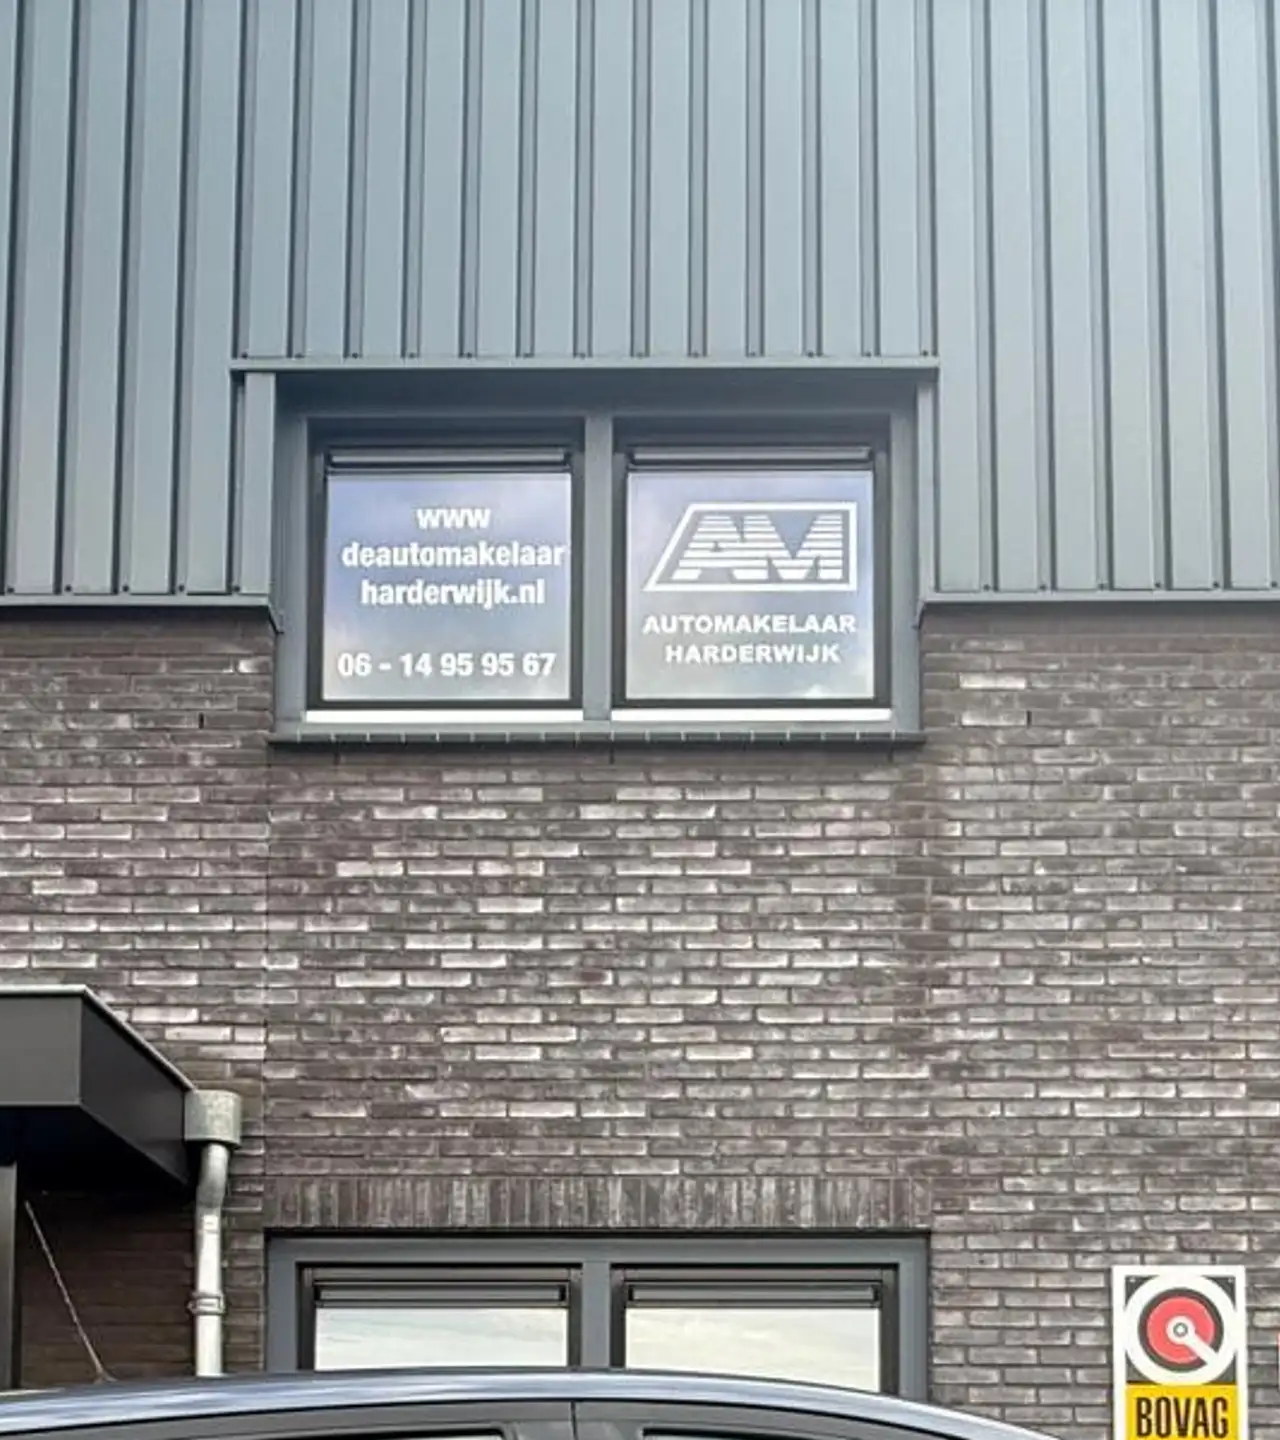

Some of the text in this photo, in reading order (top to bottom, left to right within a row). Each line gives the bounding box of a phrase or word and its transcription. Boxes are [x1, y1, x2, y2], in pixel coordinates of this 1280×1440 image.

[417, 508, 490, 530] www
[341, 540, 565, 569] deautomakelaar
[671, 513, 843, 580] AM
[361, 579, 545, 608] harderwijk.nl
[642, 614, 856, 635] AUTOMAKELAAR
[338, 652, 370, 677] 06
[400, 652, 432, 677] 14
[440, 652, 472, 677] 95
[481, 652, 514, 677] 95
[522, 652, 556, 677] 67
[665, 643, 840, 664] HARDERWIJK
[1136, 1397, 1228, 1438] BOVAG
